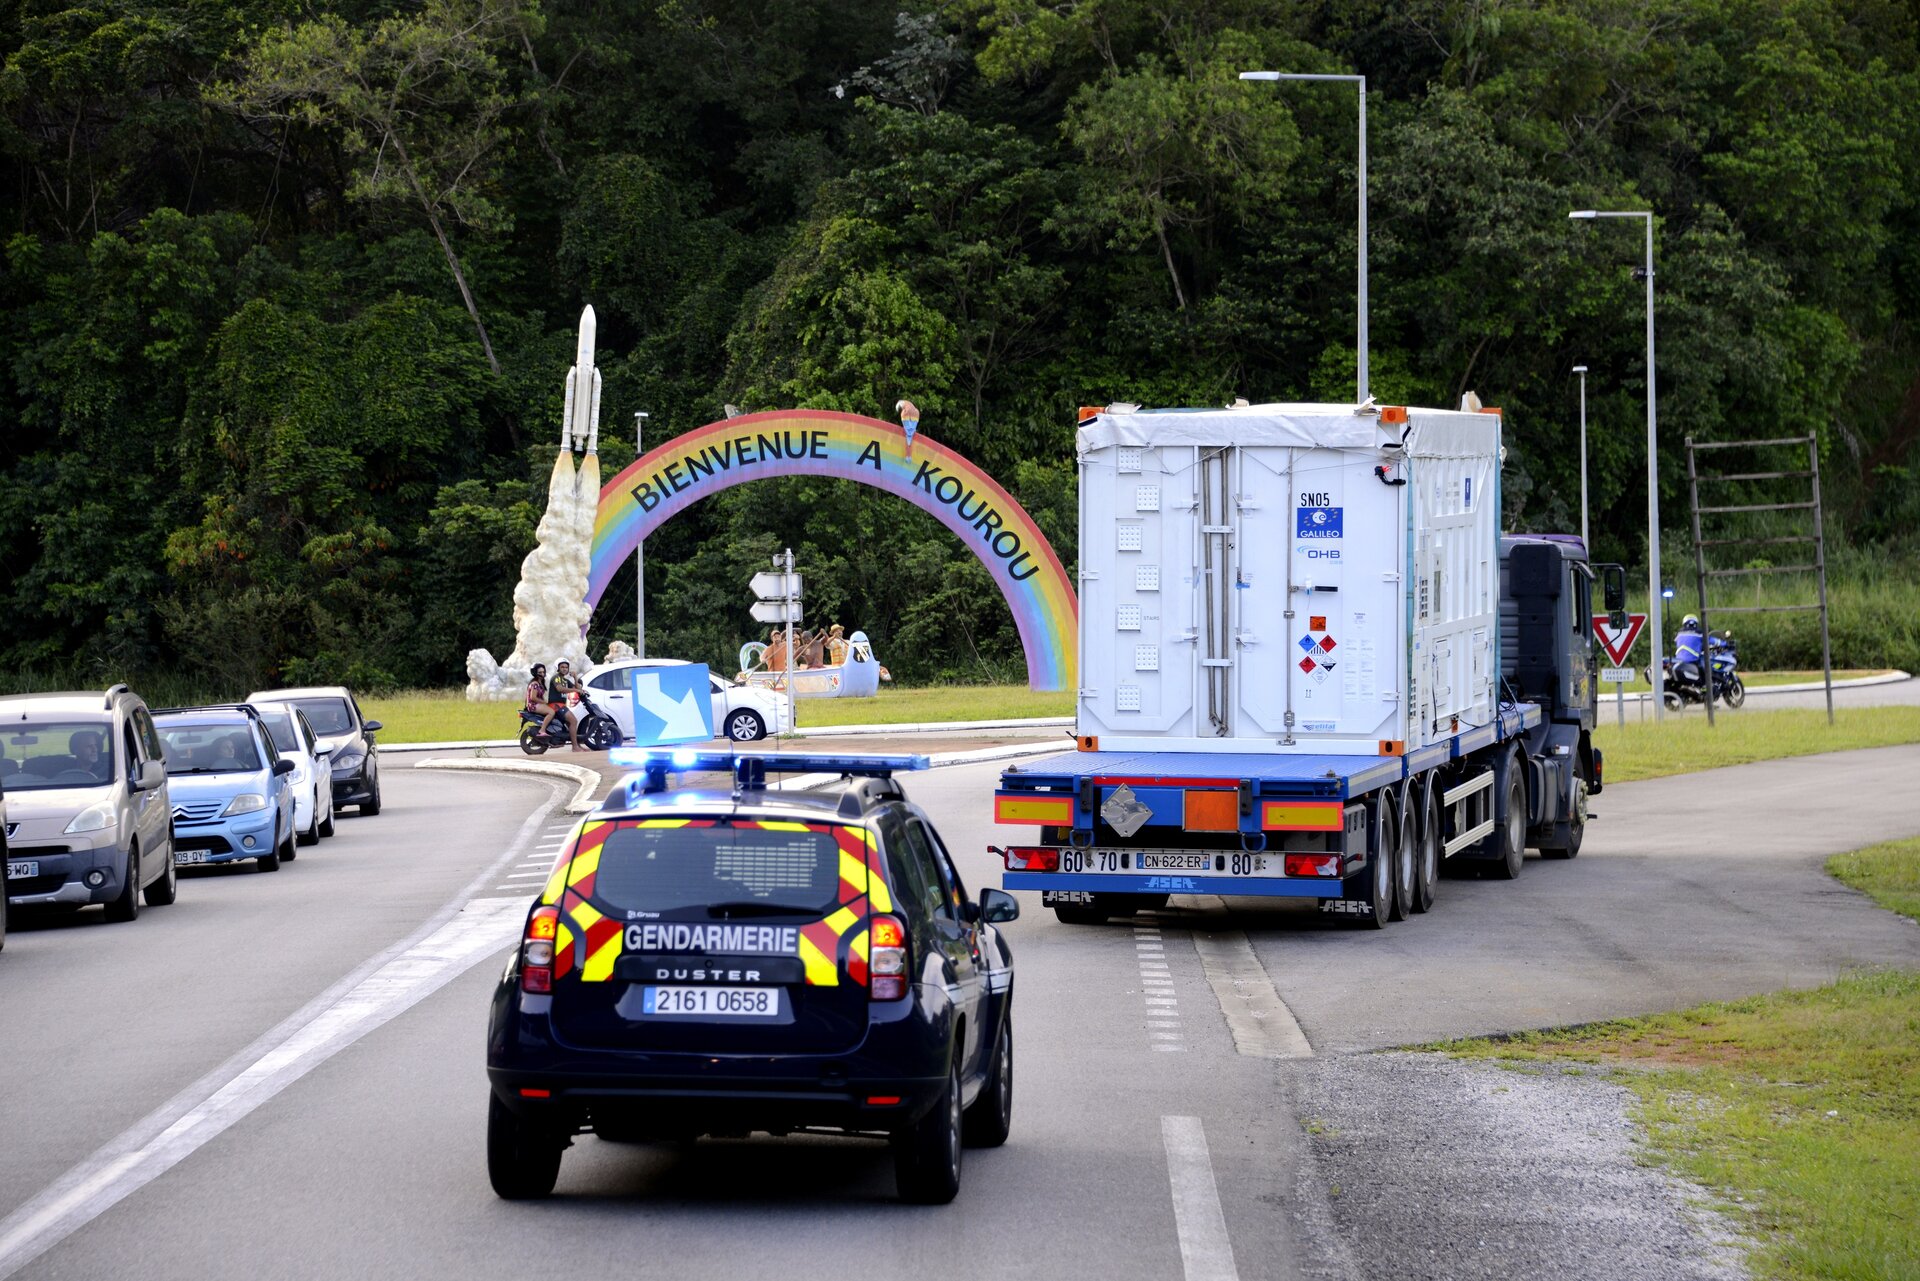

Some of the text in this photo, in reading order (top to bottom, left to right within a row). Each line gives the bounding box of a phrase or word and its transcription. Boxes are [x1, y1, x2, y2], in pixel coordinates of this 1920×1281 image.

[630, 430, 1040, 581] BIENVENUE A KOUROU
[1300, 492, 1330, 507] SN05
[1300, 530, 1340, 538] GALILEO
[1308, 550, 1341, 559] OHB
[1063, 851, 1117, 873] 60 70
[1144, 855, 1201, 868] CN-622-ER
[1231, 853, 1251, 875] 80
[625, 925, 797, 952] GENDARMERIE
[656, 969, 761, 981] DUSTER
[657, 990, 707, 1011] 2161
[716, 991, 768, 1012] 0658
